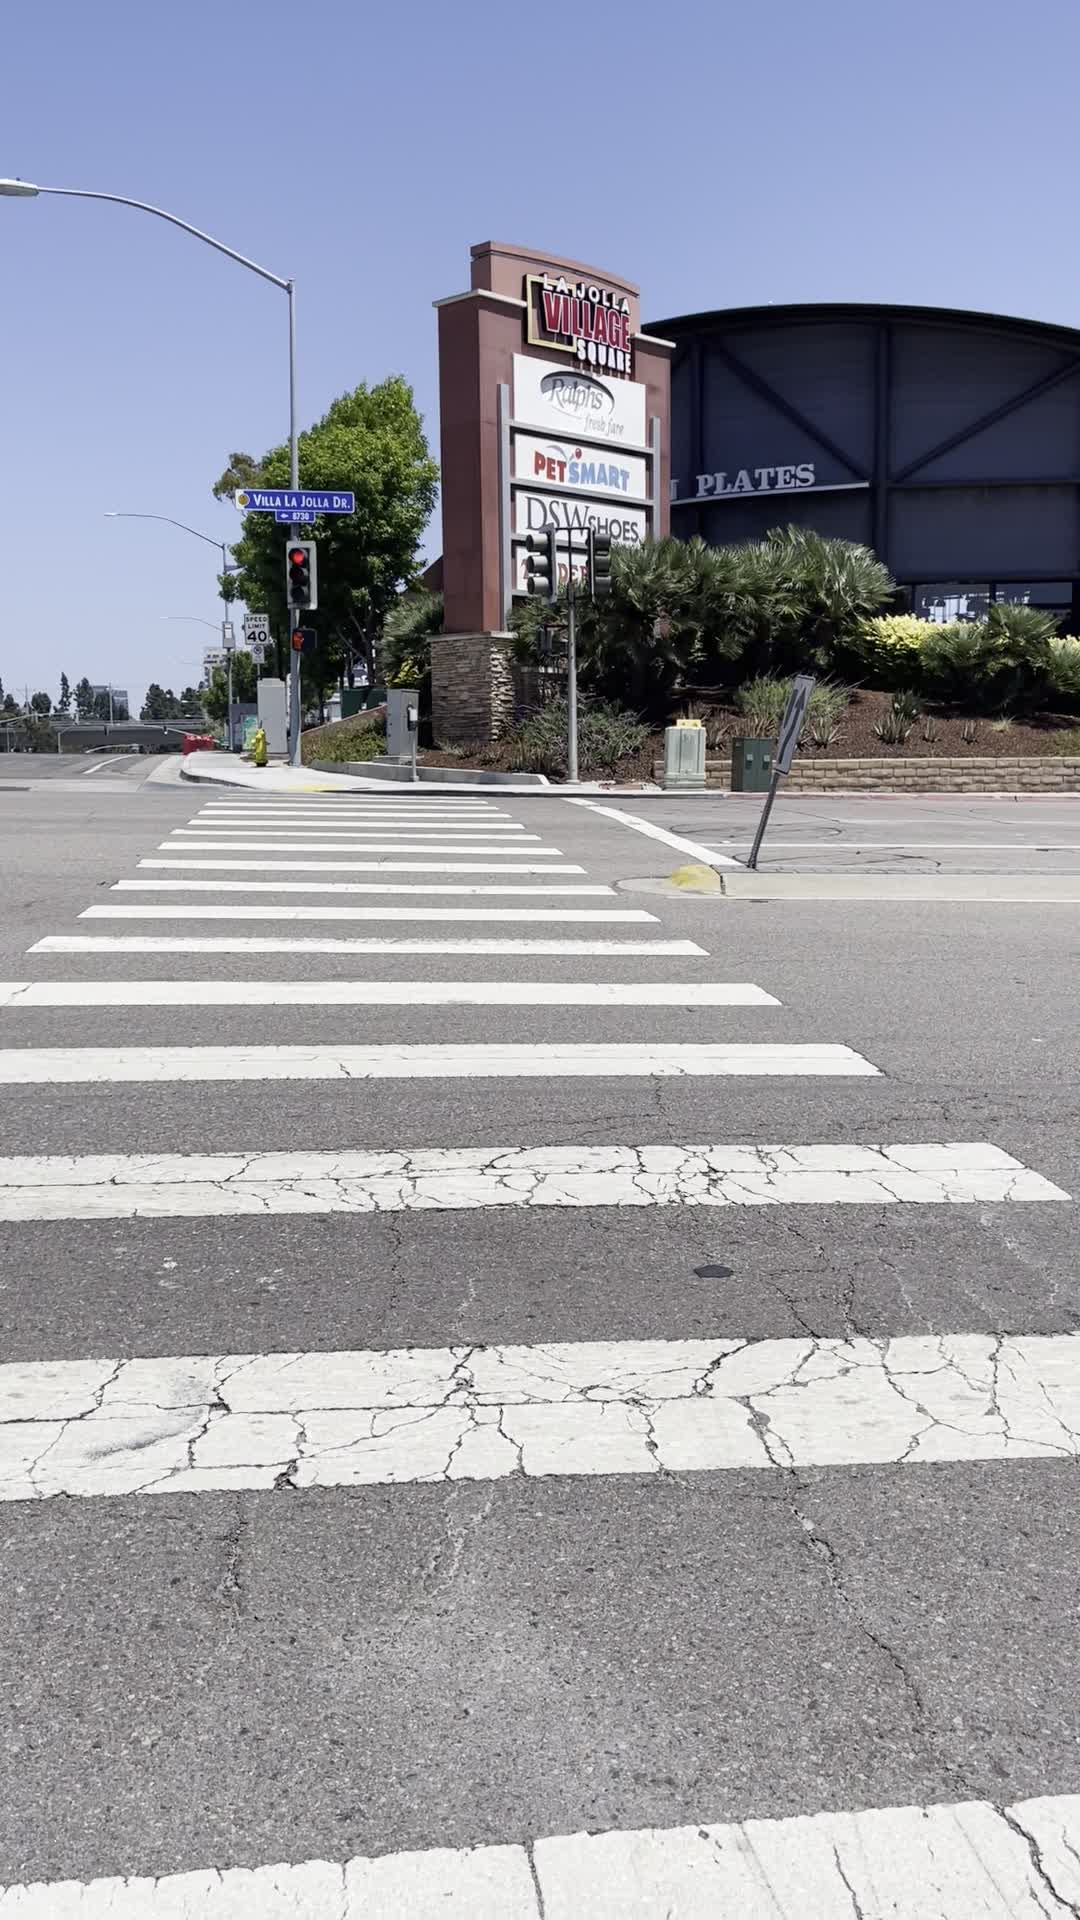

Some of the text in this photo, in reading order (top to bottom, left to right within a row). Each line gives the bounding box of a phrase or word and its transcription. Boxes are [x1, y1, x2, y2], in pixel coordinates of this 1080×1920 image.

[542, 273, 630, 314] LA JOLLA
[542, 290, 631, 352] VILLAGE
[577, 339, 631, 373] SQUARE
[549, 377, 603, 412] Ralphs
[584, 413, 625, 436] fresh fare
[696, 463, 816, 497] PLATES
[253, 494, 281, 507] VILLA
[285, 495, 297, 508] LA
[301, 495, 329, 508] JOLLA
[525, 496, 639, 543] DSW SHOES
[247, 630, 267, 642] 40
